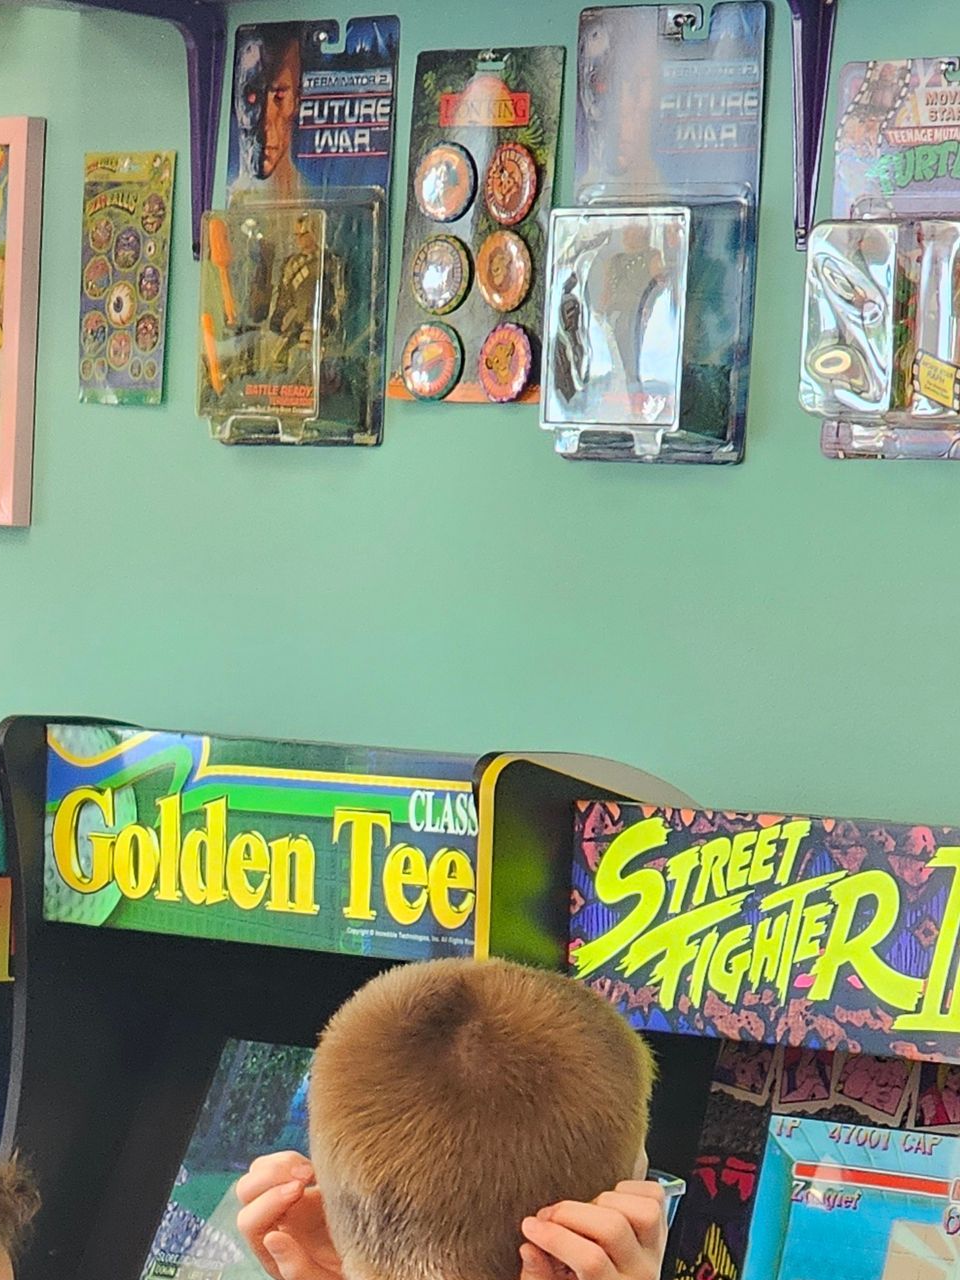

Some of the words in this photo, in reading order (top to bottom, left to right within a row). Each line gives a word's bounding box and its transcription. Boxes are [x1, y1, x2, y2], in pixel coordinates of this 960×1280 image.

[299, 98, 392, 125] FUTURE
[661, 91, 759, 117] FUTURE
[314, 128, 371, 153] WAR
[408, 788, 478, 837] CLASS
[52, 785, 320, 915] Golden
[332, 806, 476, 929] Tee
[571, 815, 812, 980] STREET
[616, 869, 926, 1012] FIGHTER
[902, 1132, 942, 1156] CAP
[790, 1180, 863, 1212] Zgief
